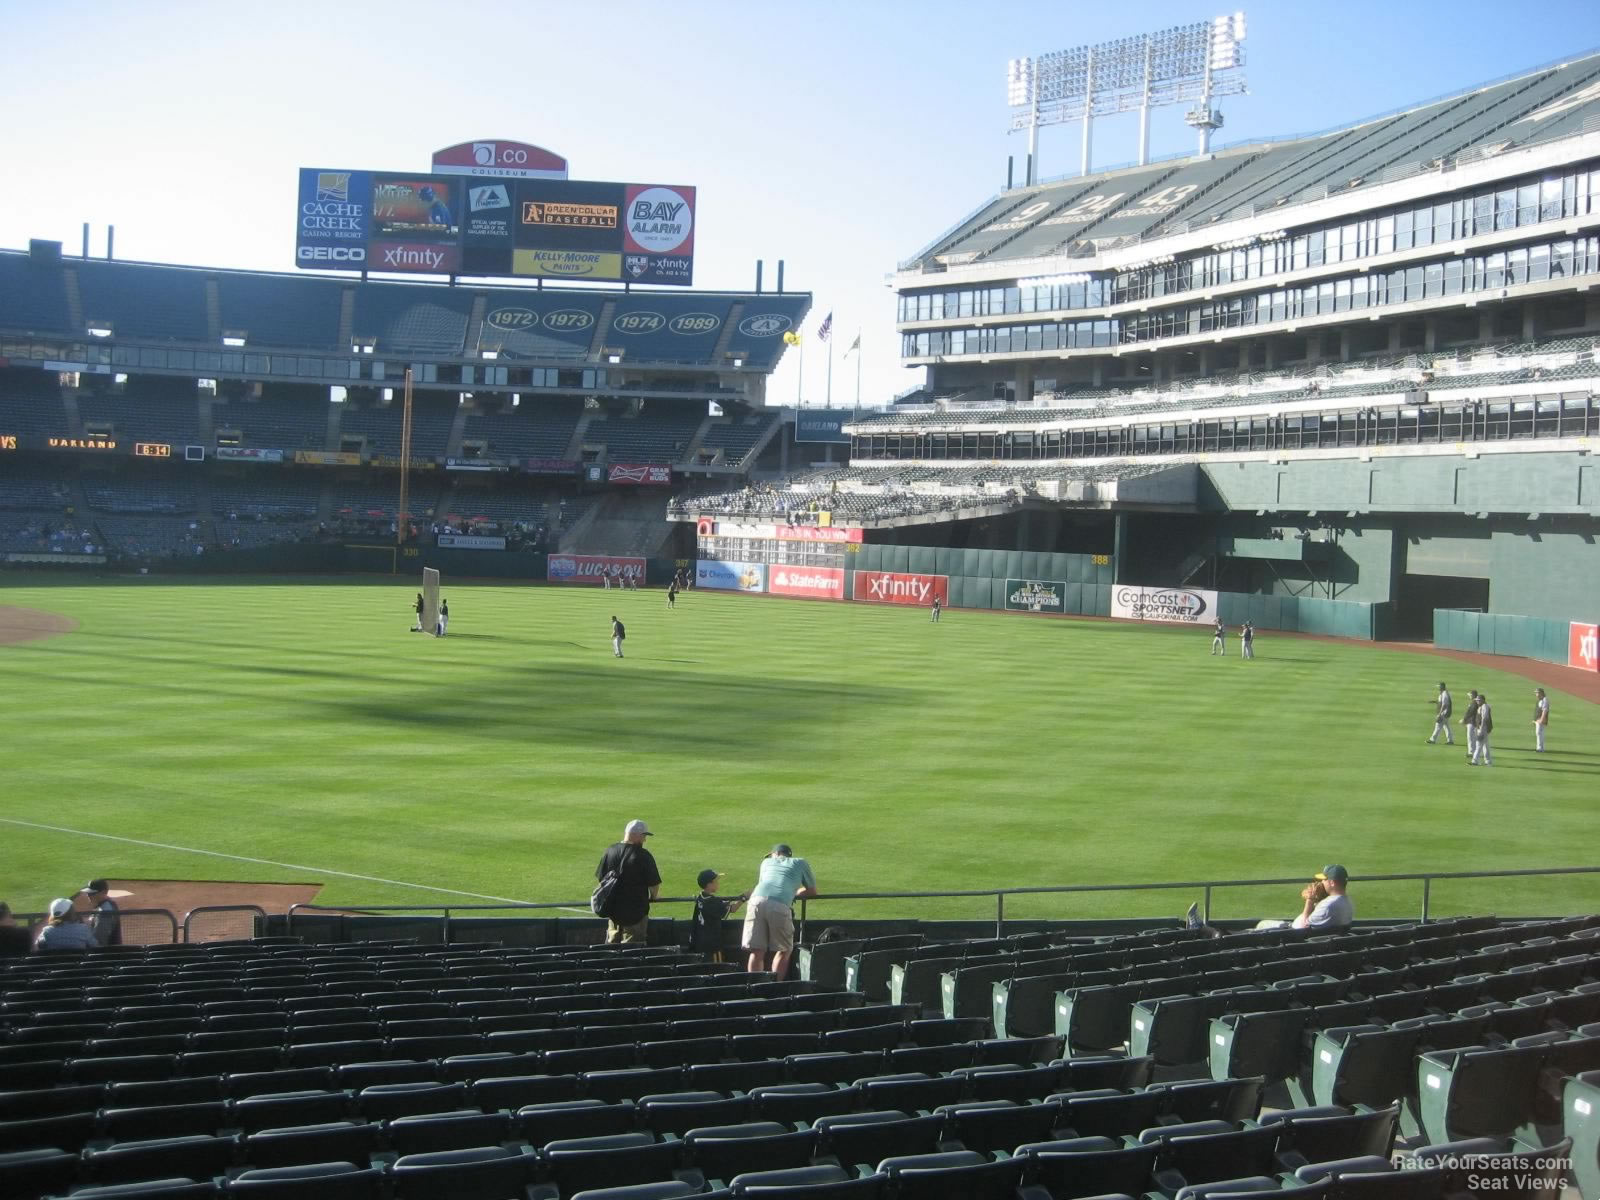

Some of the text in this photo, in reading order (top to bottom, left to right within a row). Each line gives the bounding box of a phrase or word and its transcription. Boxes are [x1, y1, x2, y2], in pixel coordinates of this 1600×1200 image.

[472, 169, 527, 177] COLISEUM
[1137, 184, 1198, 207] 43
[303, 203, 362, 217] CACHE
[547, 205, 615, 215] GREEN COLLAR
[1061, 192, 1126, 216] 24
[633, 201, 684, 221] BAY
[1011, 201, 1050, 221] 9
[303, 217, 361, 230] CREEK
[547, 215, 614, 225] BASEBALL
[303, 230, 362, 239] CASINO RESORT
[632, 222, 681, 235] ALARM
[298, 247, 366, 261] GEICO
[384, 247, 444, 268] xfinity
[533, 251, 600, 263] KELLY-MOORE
[553, 263, 580, 271] PAINTS
[656, 258, 689, 270] xfinity
[494, 313, 533, 325] 1972
[550, 314, 588, 326] 1973
[622, 317, 658, 329] 1974
[676, 318, 715, 330] 1989
[801, 422, 839, 431] OAKLAND
[1, 436, 16, 449] VS
[142, 445, 168, 455] 6:14
[1091, 554, 1109, 565] 388
[709, 570, 735, 579] Chevron
[870, 575, 931, 600] xfinity
[1010, 595, 1060, 606] CHAMPIONS
[1119, 589, 1178, 606] comcast
[1132, 603, 1194, 615] SPORTSNET
